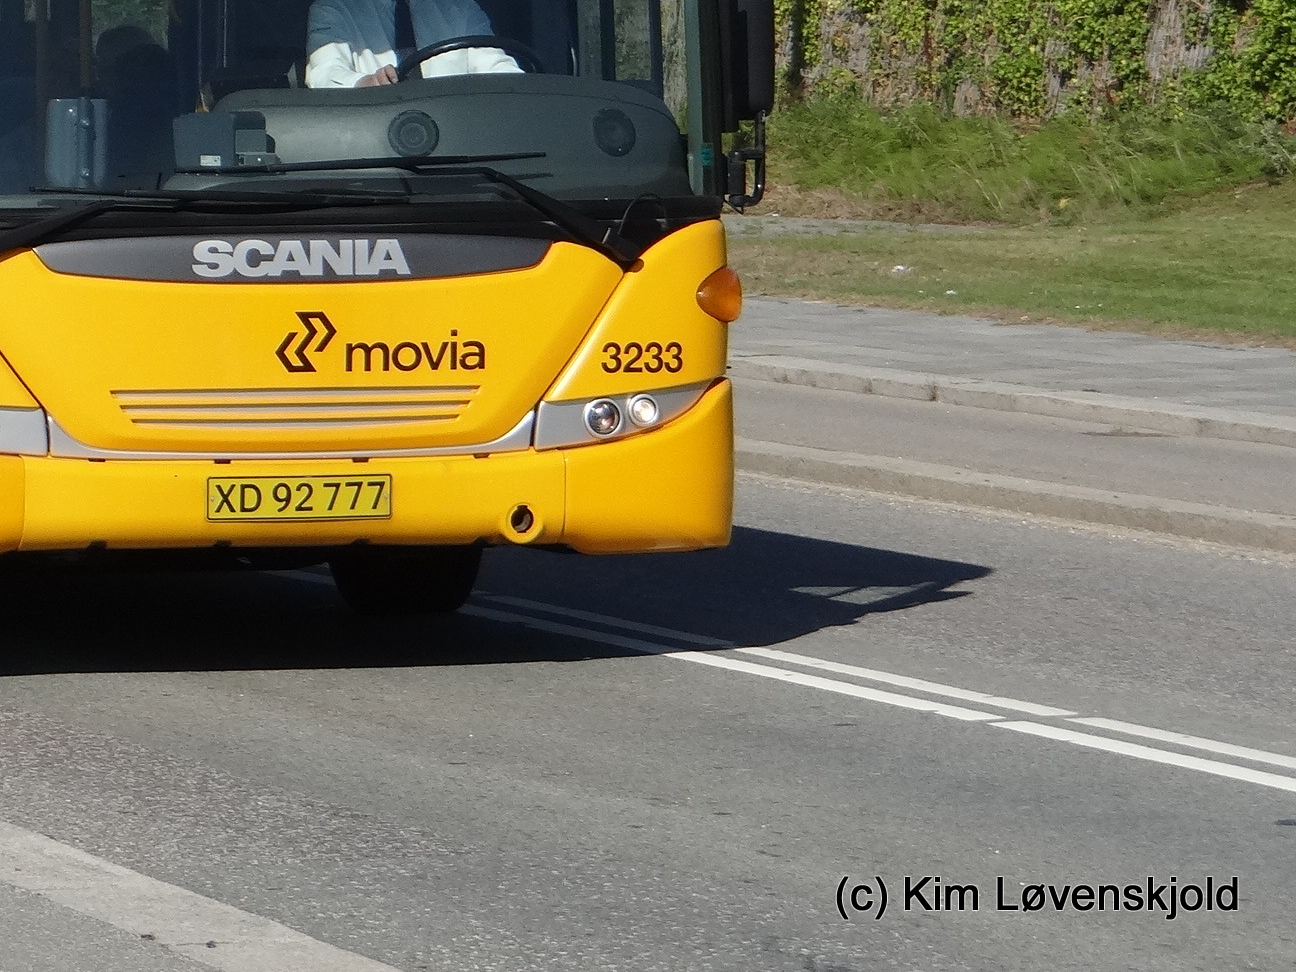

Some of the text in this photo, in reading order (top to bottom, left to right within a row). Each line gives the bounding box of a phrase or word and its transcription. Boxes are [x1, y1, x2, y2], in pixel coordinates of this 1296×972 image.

[192, 239, 411, 278] SCANIA
[345, 330, 486, 372] movia
[602, 342, 683, 373] 3233
[215, 480, 386, 514] XD 92 777
